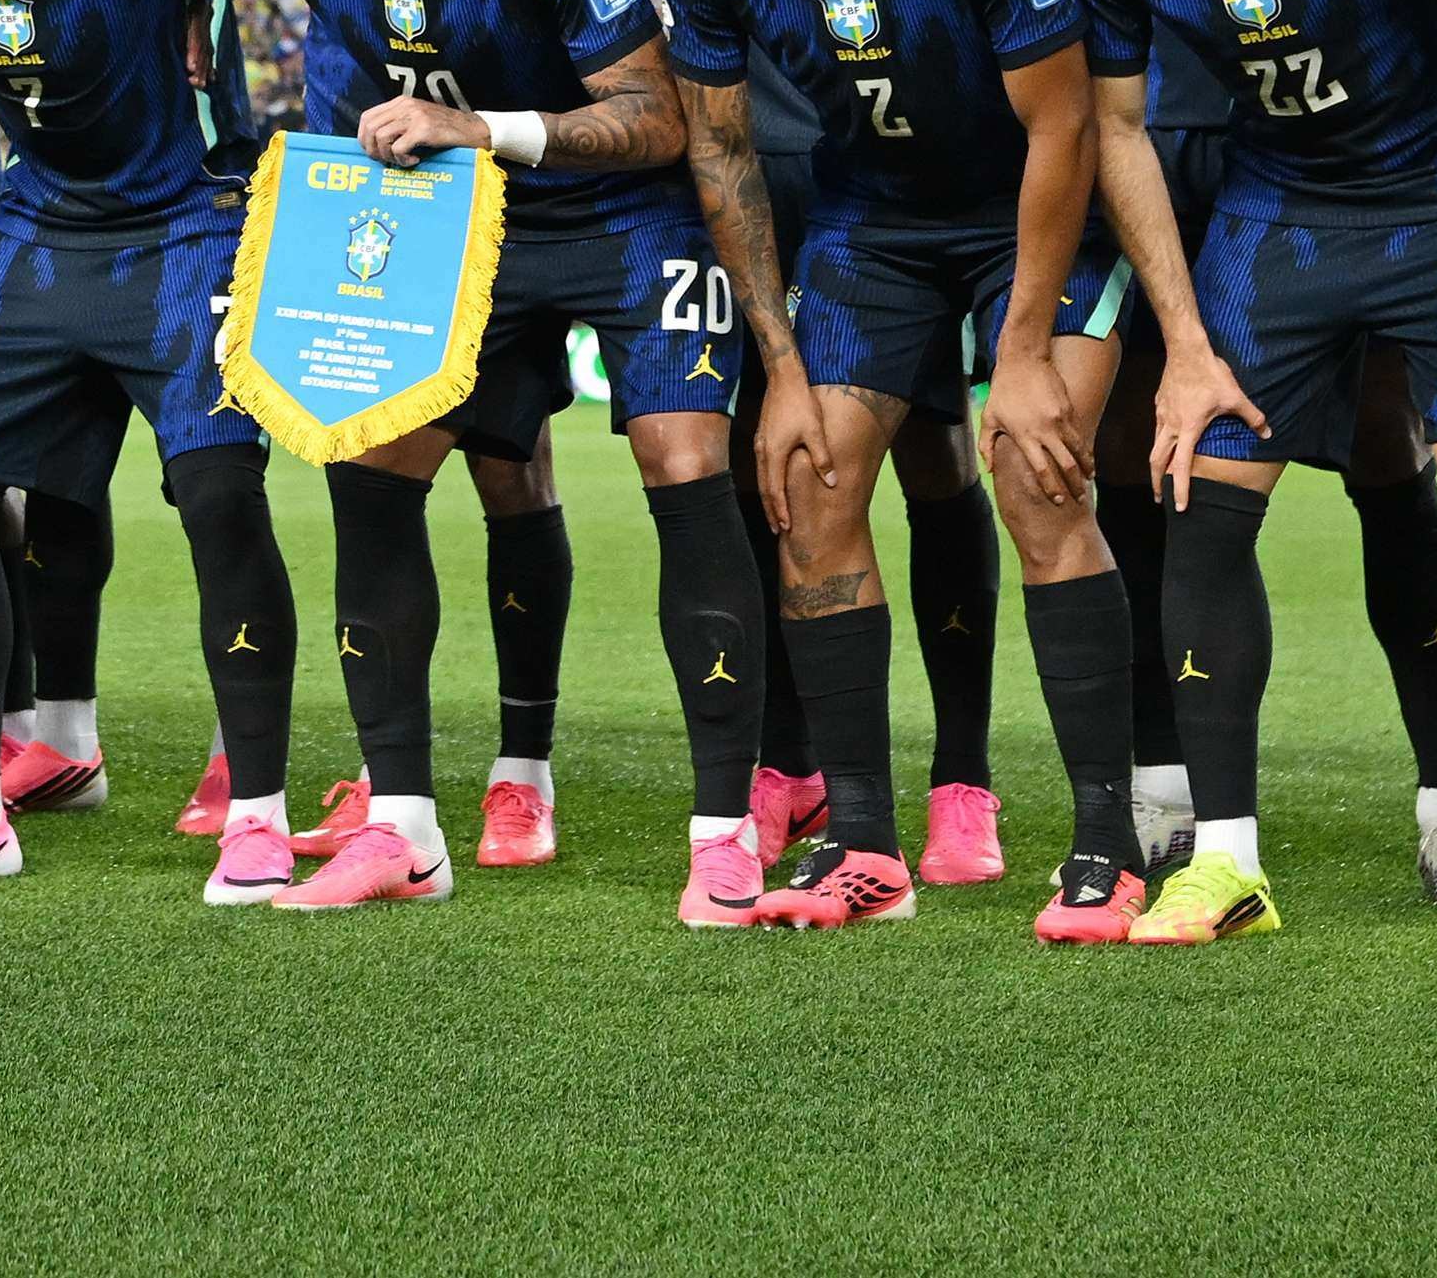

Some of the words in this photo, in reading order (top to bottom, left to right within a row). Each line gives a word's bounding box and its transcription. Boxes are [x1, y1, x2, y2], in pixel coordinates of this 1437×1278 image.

[841, 6, 860, 17] CBF
[1238, 24, 1299, 45] BRASIL
[389, 37, 438, 54] BRASIL
[836, 46, 892, 62] BRASIL
[1240, 47, 1349, 116] 22
[8, 77, 43, 128] 7
[855, 78, 914, 137] 2
[307, 161, 370, 192] CBF
[337, 283, 385, 299] BRASIL
[661, 259, 732, 334] 20
[312, 338, 346, 351] BRASIL
[359, 344, 386, 356] HAITI
